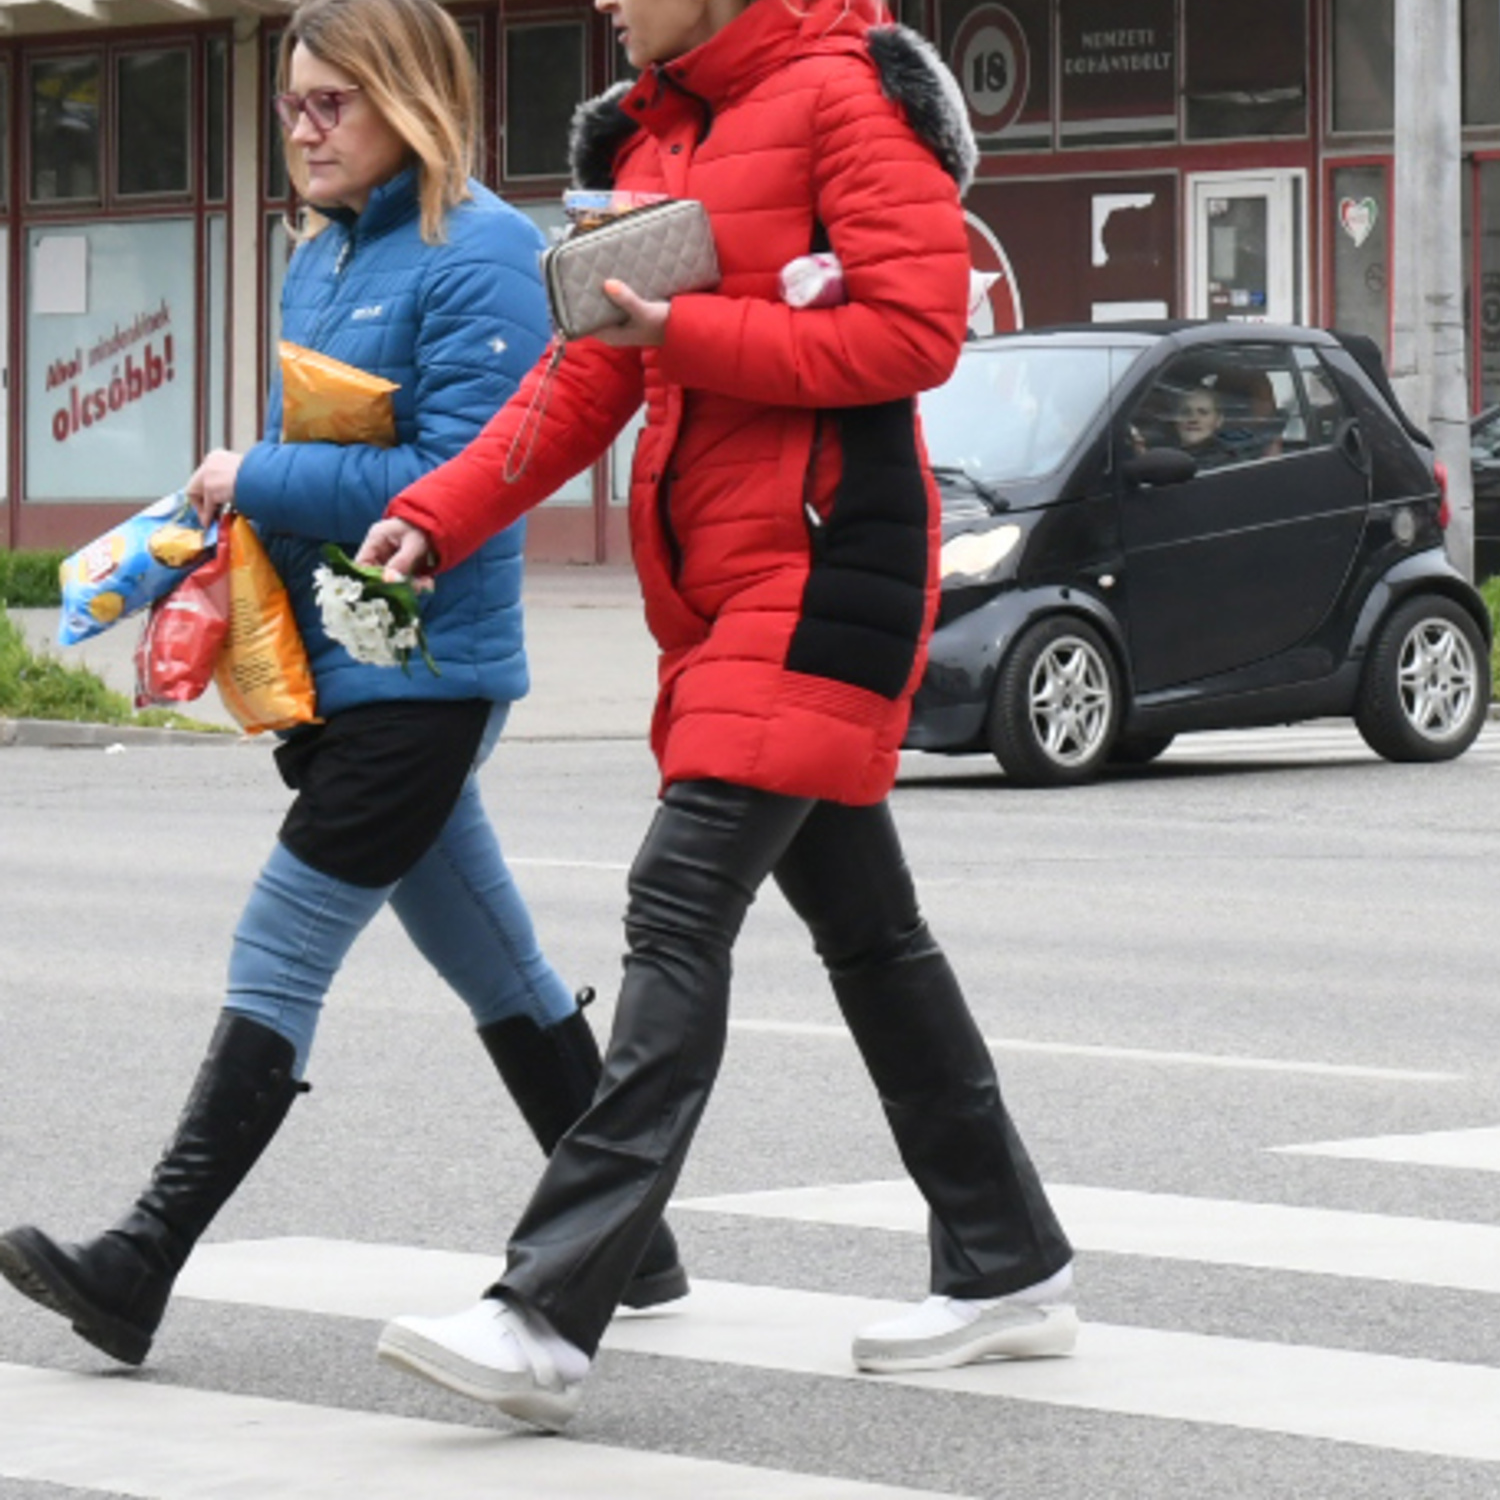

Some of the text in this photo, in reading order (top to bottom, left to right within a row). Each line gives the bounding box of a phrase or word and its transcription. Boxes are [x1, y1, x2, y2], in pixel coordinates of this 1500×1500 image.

[1081, 29, 1155, 49] NEMZETI
[973, 52, 1007, 92] 18
[52, 333, 174, 442] olcsóbb!
